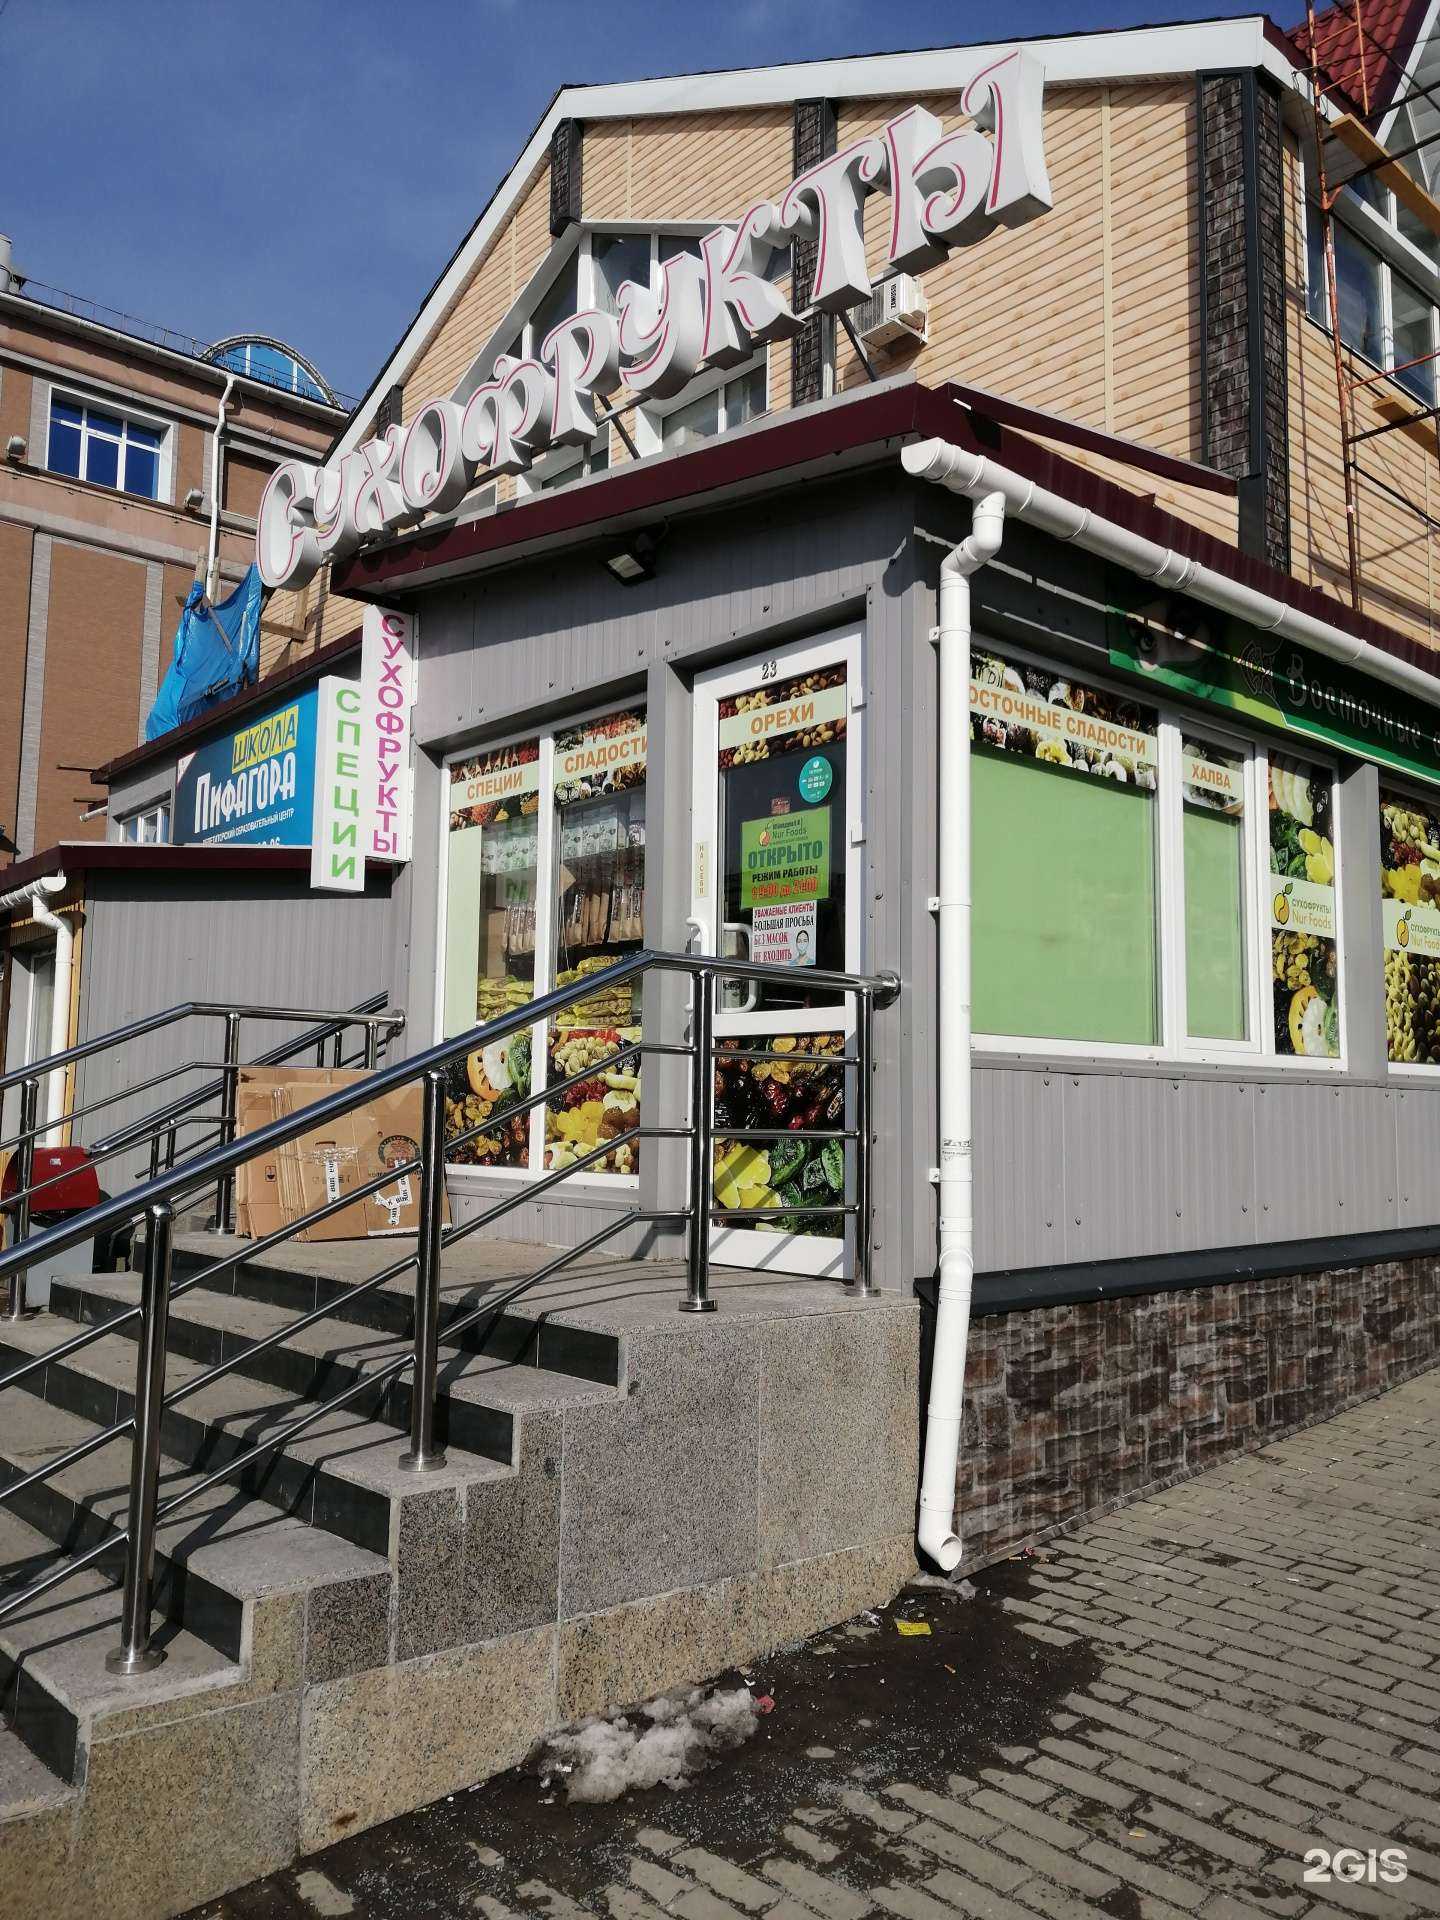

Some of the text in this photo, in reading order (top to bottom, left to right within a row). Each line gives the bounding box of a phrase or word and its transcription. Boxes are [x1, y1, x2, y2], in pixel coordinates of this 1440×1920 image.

[761, 660, 777, 680] 23
[751, 702, 814, 735] ОРЕХИ
[969, 686, 1146, 755] ОСТОЧНЫЕ СЛАДОСТИ
[234, 713, 295, 767] ШКОЛА
[373, 614, 405, 854] СУХОФРУКТЫ
[332, 688, 360, 879] СПЕЦИИ
[467, 771, 523, 800] СПЕЦИИ
[1191, 763, 1232, 789] ХАЛВА
[748, 840, 823, 869] ОТКРЫТО
[752, 865, 818, 883] РЕЖИМ РАБОТЫ
[754, 902, 815, 918] УВАЖАЕМЫЕ КЛИЕНТЫ
[754, 914, 814, 932] БОЛЬШАЯ ПРОСЬБА
[754, 931, 788, 945] БЕЗ МАСОК
[763, 948, 792, 962] ВХОДИТЬ
